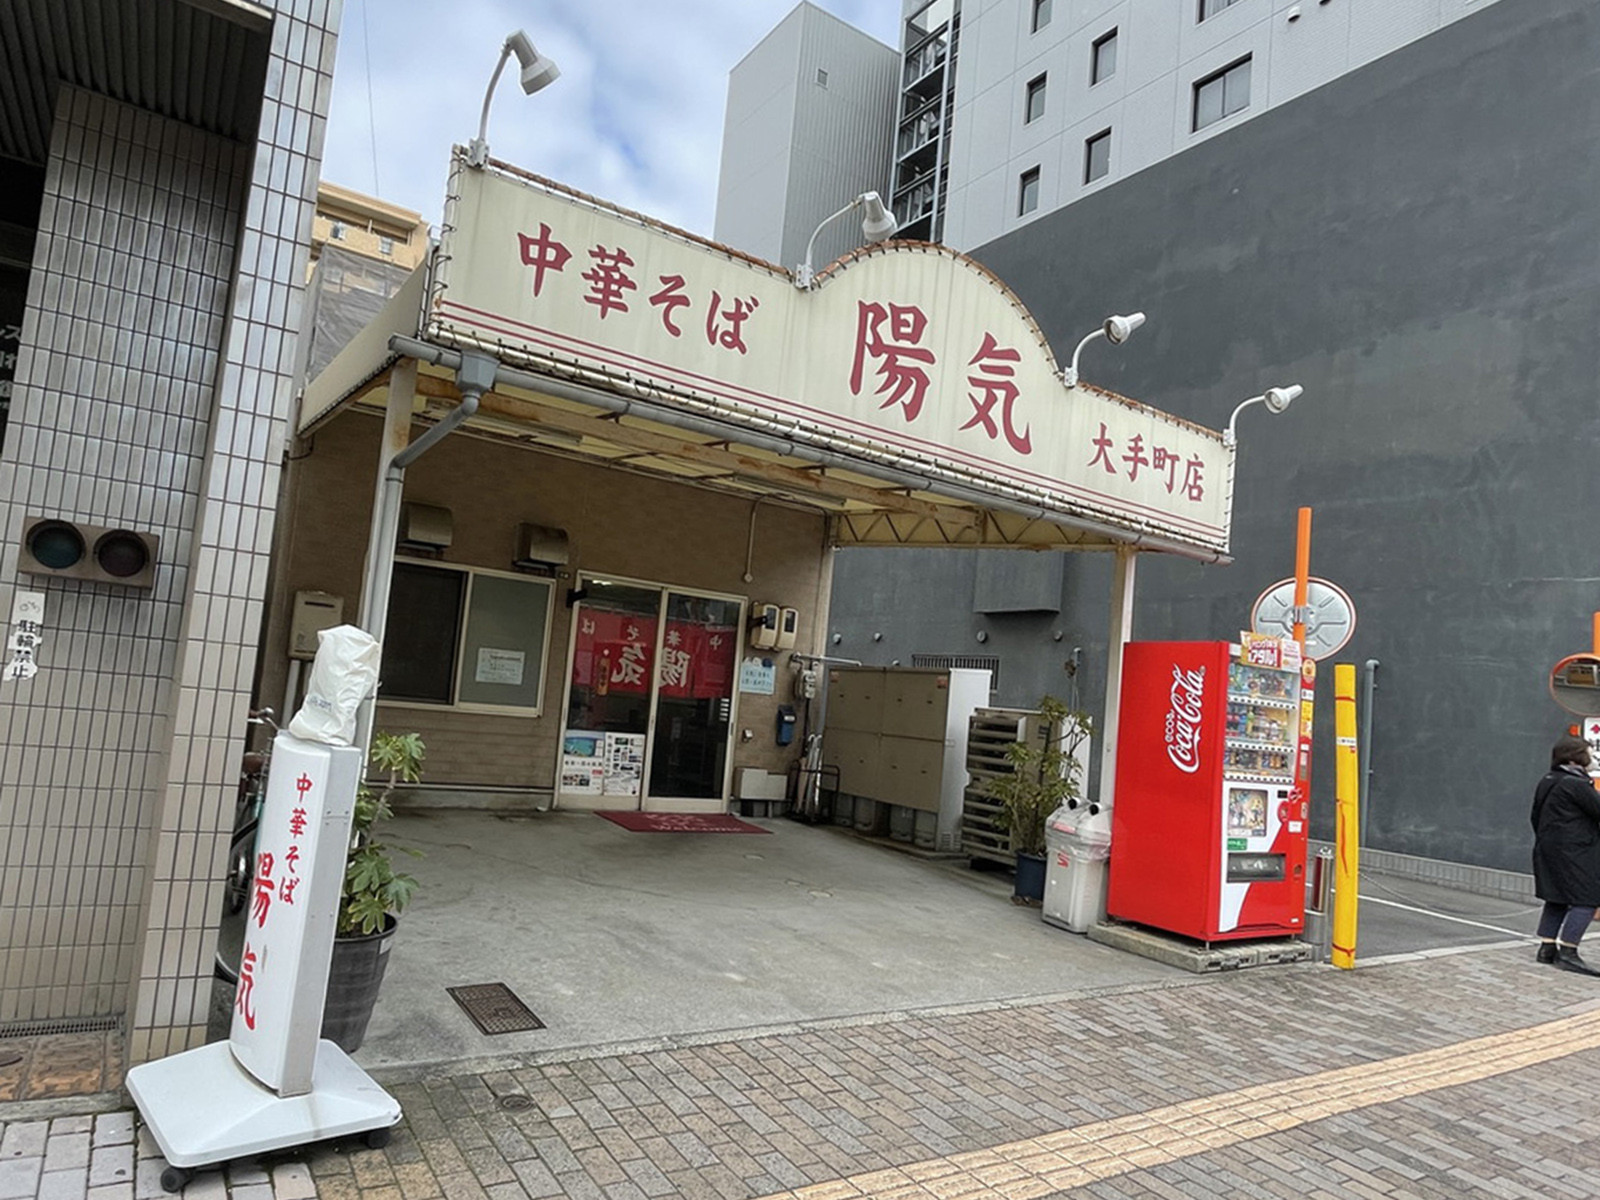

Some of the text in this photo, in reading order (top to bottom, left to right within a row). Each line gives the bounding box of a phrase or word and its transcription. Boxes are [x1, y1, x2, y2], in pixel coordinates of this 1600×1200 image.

[517, 222, 1207, 503] 中華そば 陽気 大手町店
[279, 772, 314, 906] 中華そば
